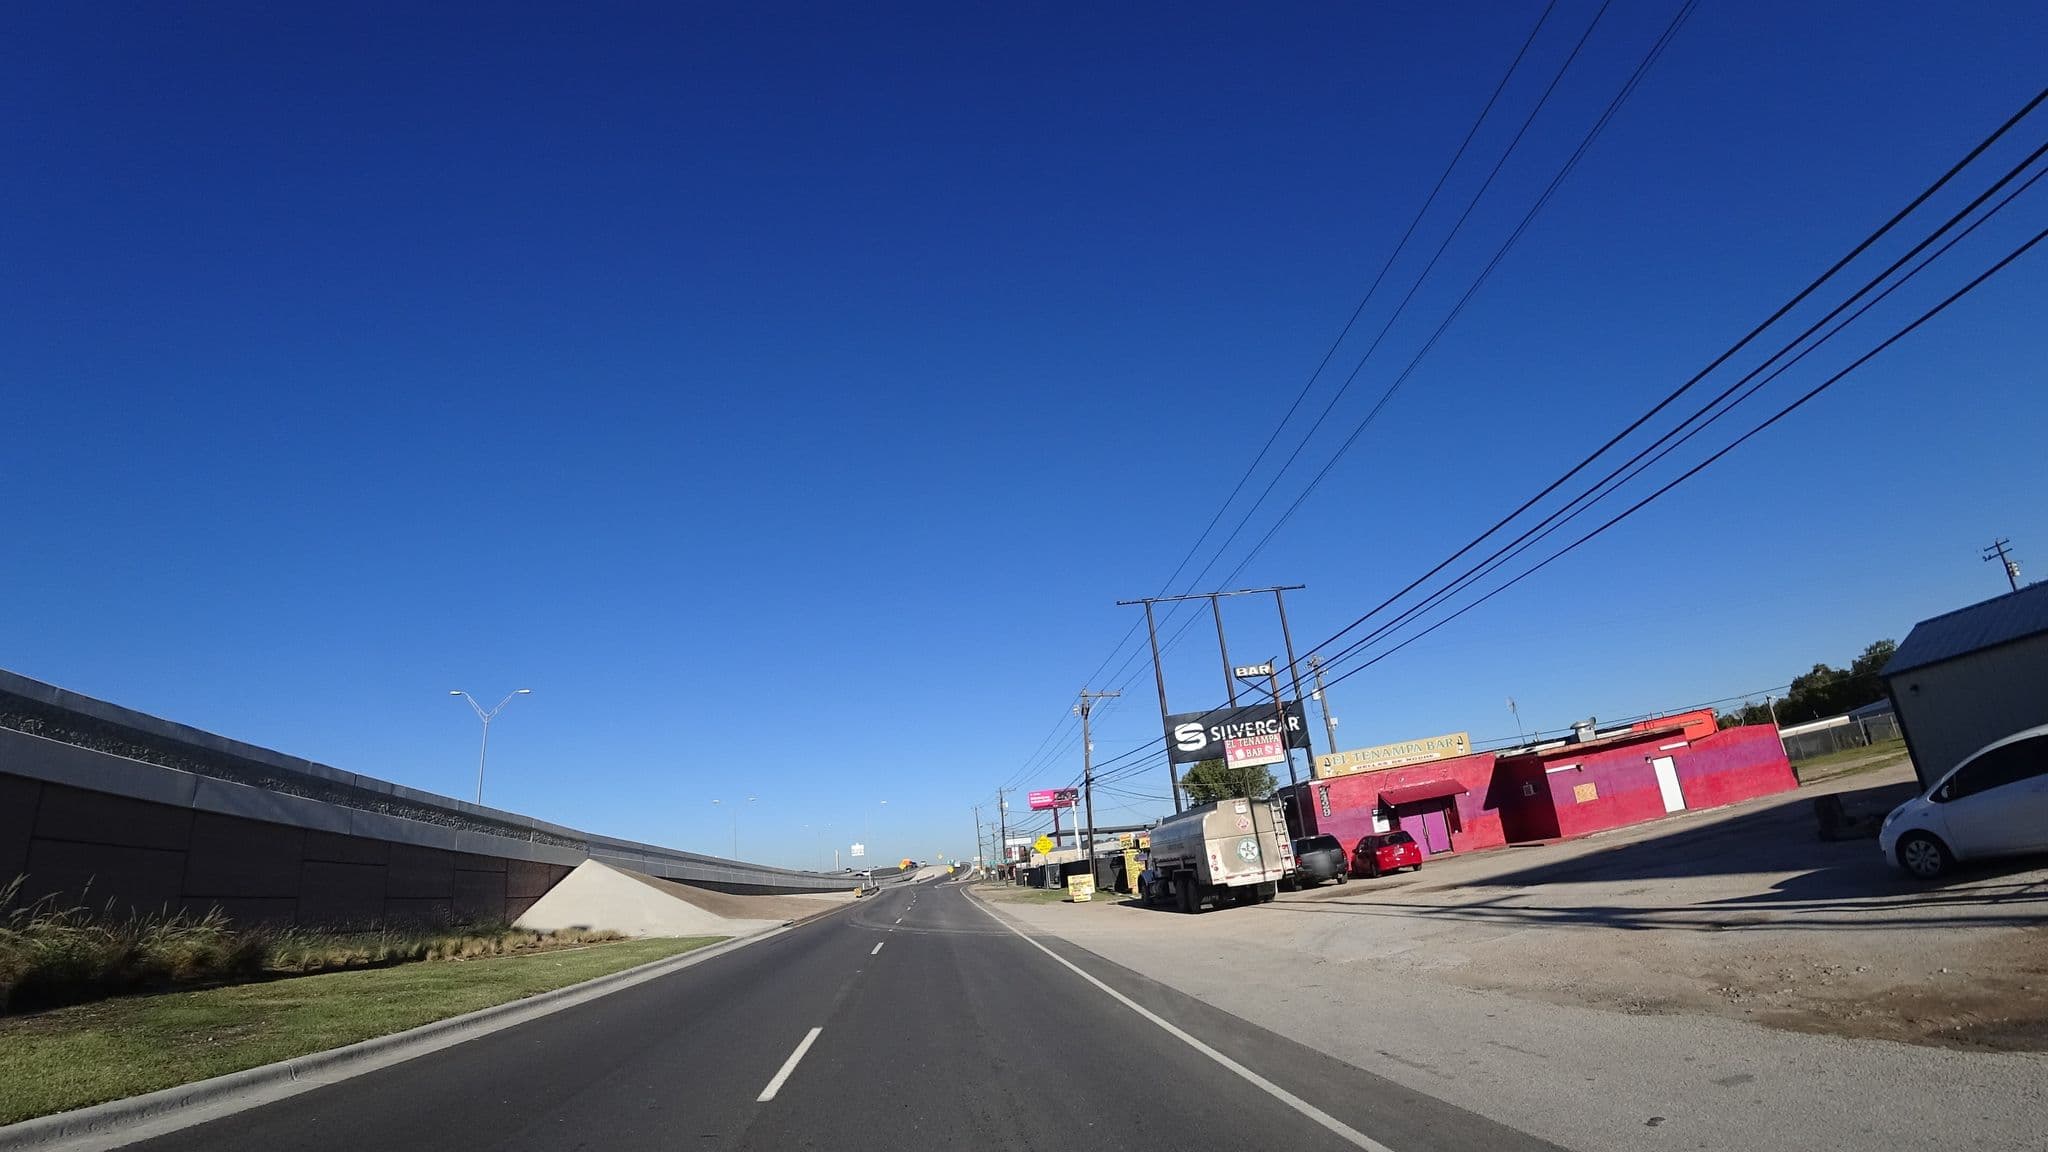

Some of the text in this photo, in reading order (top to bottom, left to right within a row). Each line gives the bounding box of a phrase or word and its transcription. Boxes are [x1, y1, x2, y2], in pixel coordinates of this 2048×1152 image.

[1235, 665, 1270, 677] BAR
[1239, 734, 1279, 747] TENAMPA
[1246, 747, 1264, 758] BAR
[1352, 742, 1423, 761] TENAMPA
[1426, 737, 1454, 751] BAR
